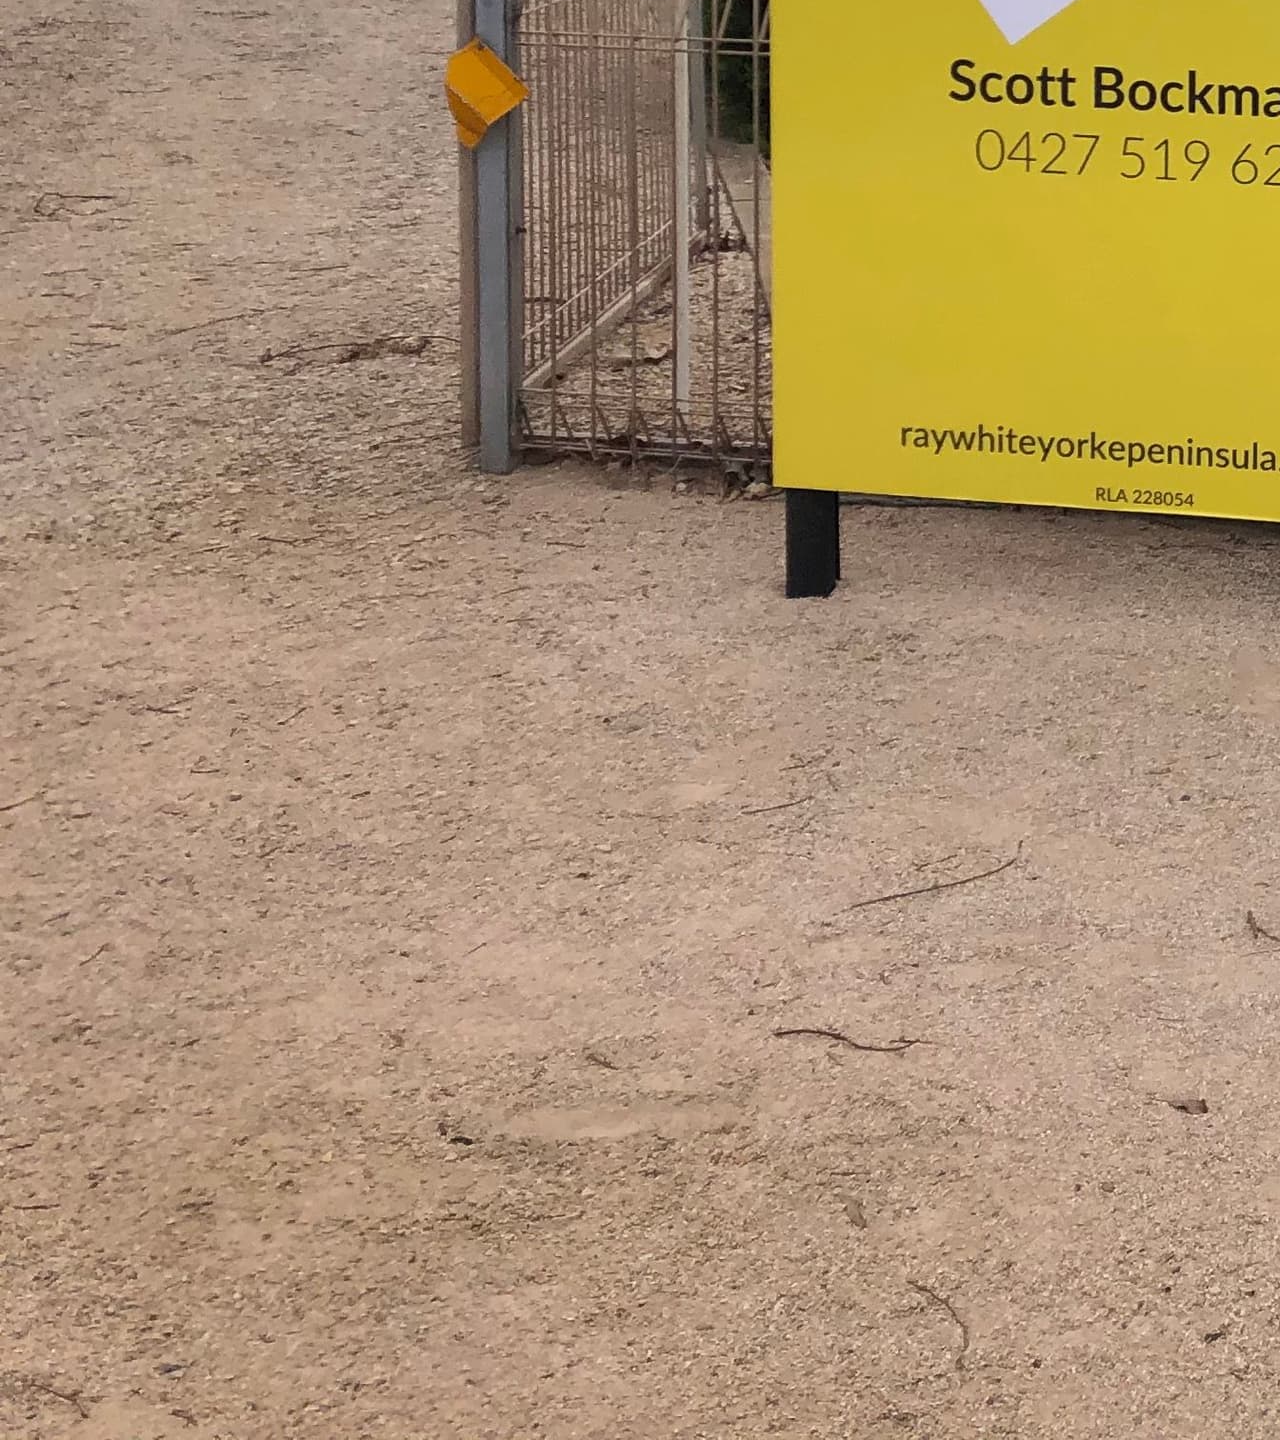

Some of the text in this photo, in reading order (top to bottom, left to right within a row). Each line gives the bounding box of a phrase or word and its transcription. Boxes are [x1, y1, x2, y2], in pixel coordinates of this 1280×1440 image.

[948, 58, 1077, 108] Scott
[974, 128, 1100, 176] 0427
[1119, 136, 1211, 182] 519
[1095, 486, 1195, 508] RLA 228054
